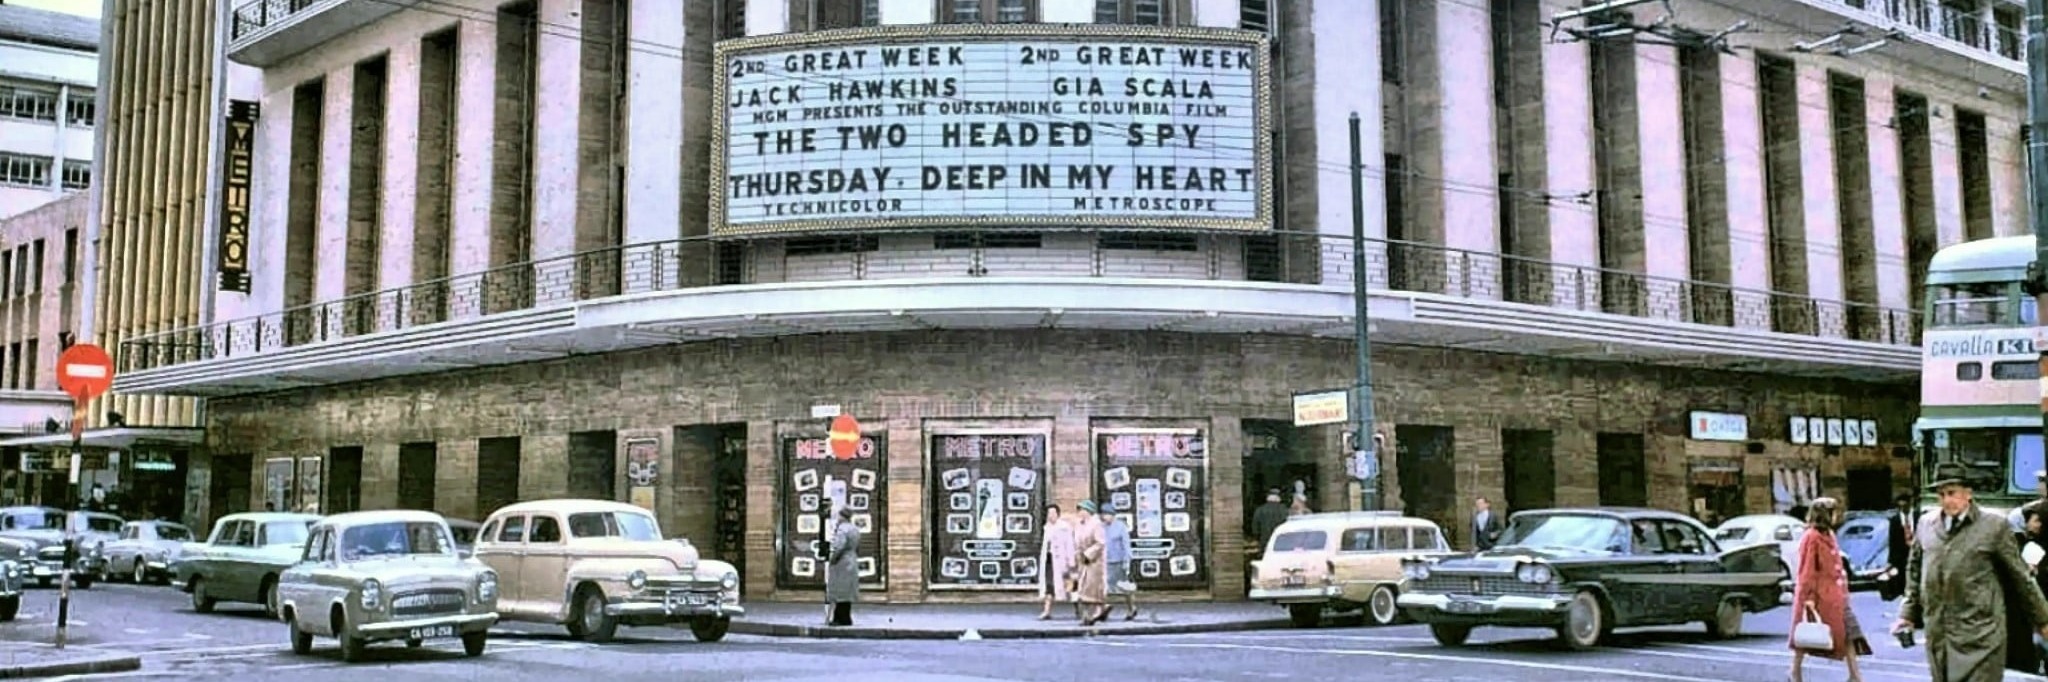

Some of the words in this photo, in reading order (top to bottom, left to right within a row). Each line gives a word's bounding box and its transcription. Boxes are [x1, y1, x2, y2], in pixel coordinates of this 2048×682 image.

[731, 60, 765, 78] 2ND
[784, 50, 868, 73] GREAT
[881, 46, 964, 68] WEEK
[1020, 46, 1061, 66] 2ND
[1076, 46, 1166, 66] GREAT
[1178, 48, 1251, 70] WEEK
[730, 85, 801, 108] JACK
[829, 77, 958, 102] HAWKINS
[1053, 77, 1104, 97] GIA
[1124, 77, 1214, 99] SCALA
[753, 109, 788, 124] MGM
[802, 103, 884, 121] PRESENTS
[897, 102, 926, 117] THE
[939, 100, 1063, 116] OUTSTANDING
[1078, 101, 1170, 116] COLUMBIA
[1186, 103, 1227, 117] FILM
[753, 128, 817, 156] THE
[837, 123, 907, 151] TWO
[942, 122, 1093, 149] HEADED
[1126, 122, 1201, 149] SPY
[921, 163, 1007, 191] DEEP
[1020, 163, 1051, 189] IN
[1067, 164, 1115, 190] MY
[1135, 165, 1252, 193] HEART
[225, 121, 252, 269] METRO
[1073, 197, 1216, 212] METROSCOPE
[763, 198, 902, 217] TECHNICOLOR
[1794, 420, 1875, 441] PINNS
[796, 438, 874, 459] MEO
[945, 436, 1035, 458] METRO
[1107, 435, 1189, 457] METRO
